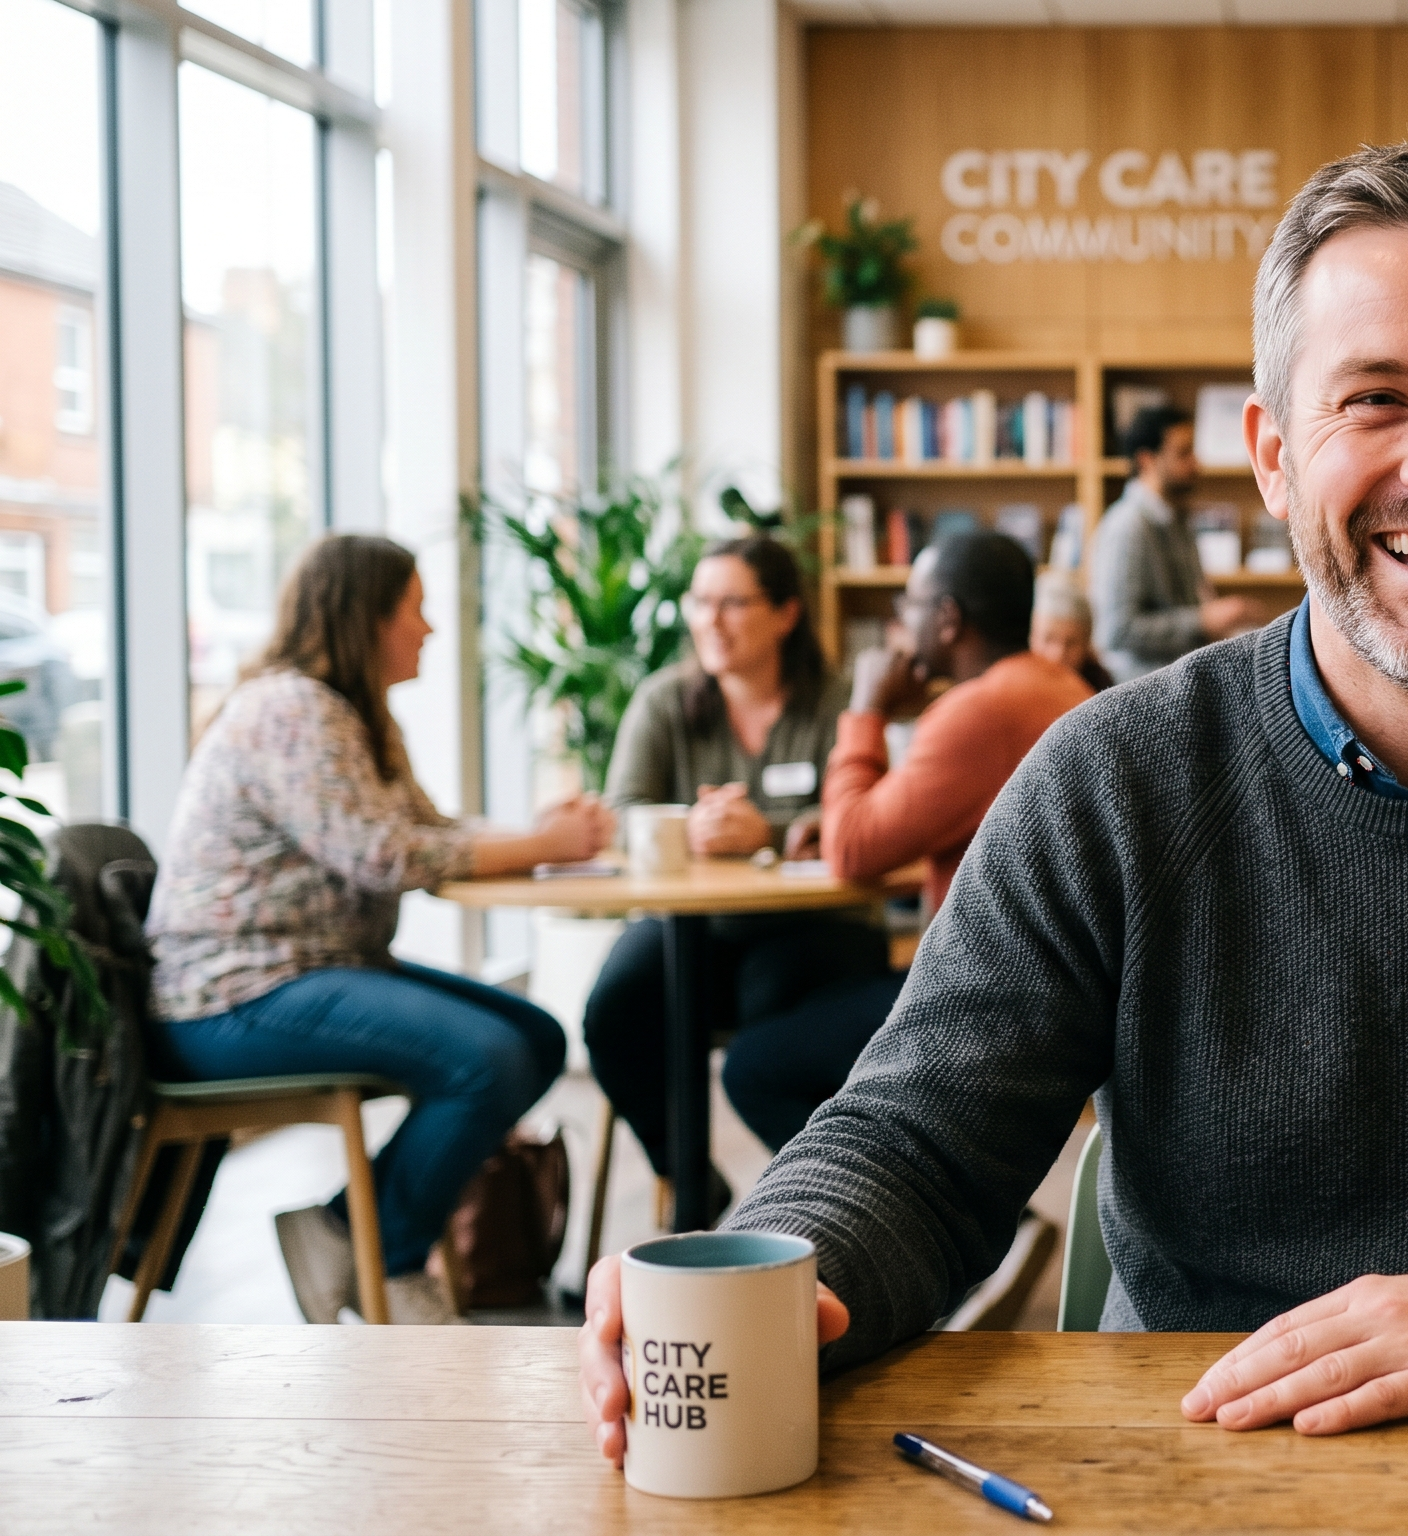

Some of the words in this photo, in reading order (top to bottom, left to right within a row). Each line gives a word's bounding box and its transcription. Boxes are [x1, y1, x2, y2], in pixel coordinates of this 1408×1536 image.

[941, 149, 1090, 208] CITY
[1101, 149, 1277, 208] CARE
[941, 213, 1279, 263] COMMUNITY
[643, 1340, 712, 1367] CITY
[643, 1371, 728, 1399] CARE
[645, 1402, 707, 1430] HUB
